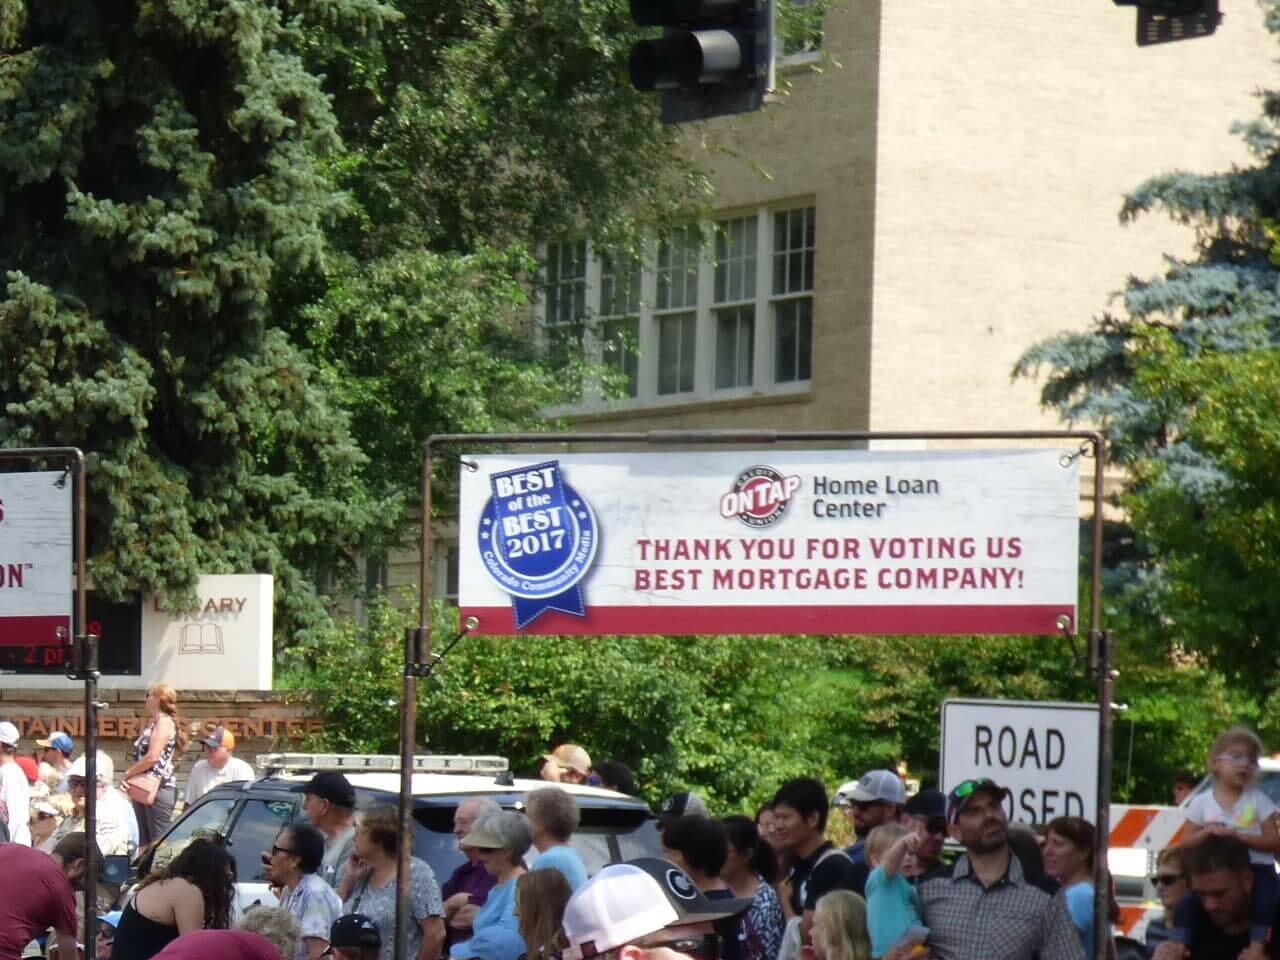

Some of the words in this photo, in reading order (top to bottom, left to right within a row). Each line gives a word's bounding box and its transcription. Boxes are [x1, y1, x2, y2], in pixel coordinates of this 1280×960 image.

[495, 467, 556, 498] BEST
[813, 475, 878, 495] Home
[885, 475, 939, 495] Loan
[507, 497, 524, 512] of
[526, 493, 552, 508] the
[813, 499, 887, 518] Center
[502, 507, 562, 537] BEST
[506, 529, 566, 558] 2017
[636, 538, 731, 561] THANK
[739, 537, 795, 560] YOU
[806, 537, 860, 560] FOR
[870, 537, 977, 560] VOTING
[987, 536, 1022, 559] US
[634, 568, 702, 591] BEST
[712, 568, 868, 591] MORTGAGE
[877, 567, 1024, 590] COMPANY!
[975, 725, 1066, 771] ROAD
